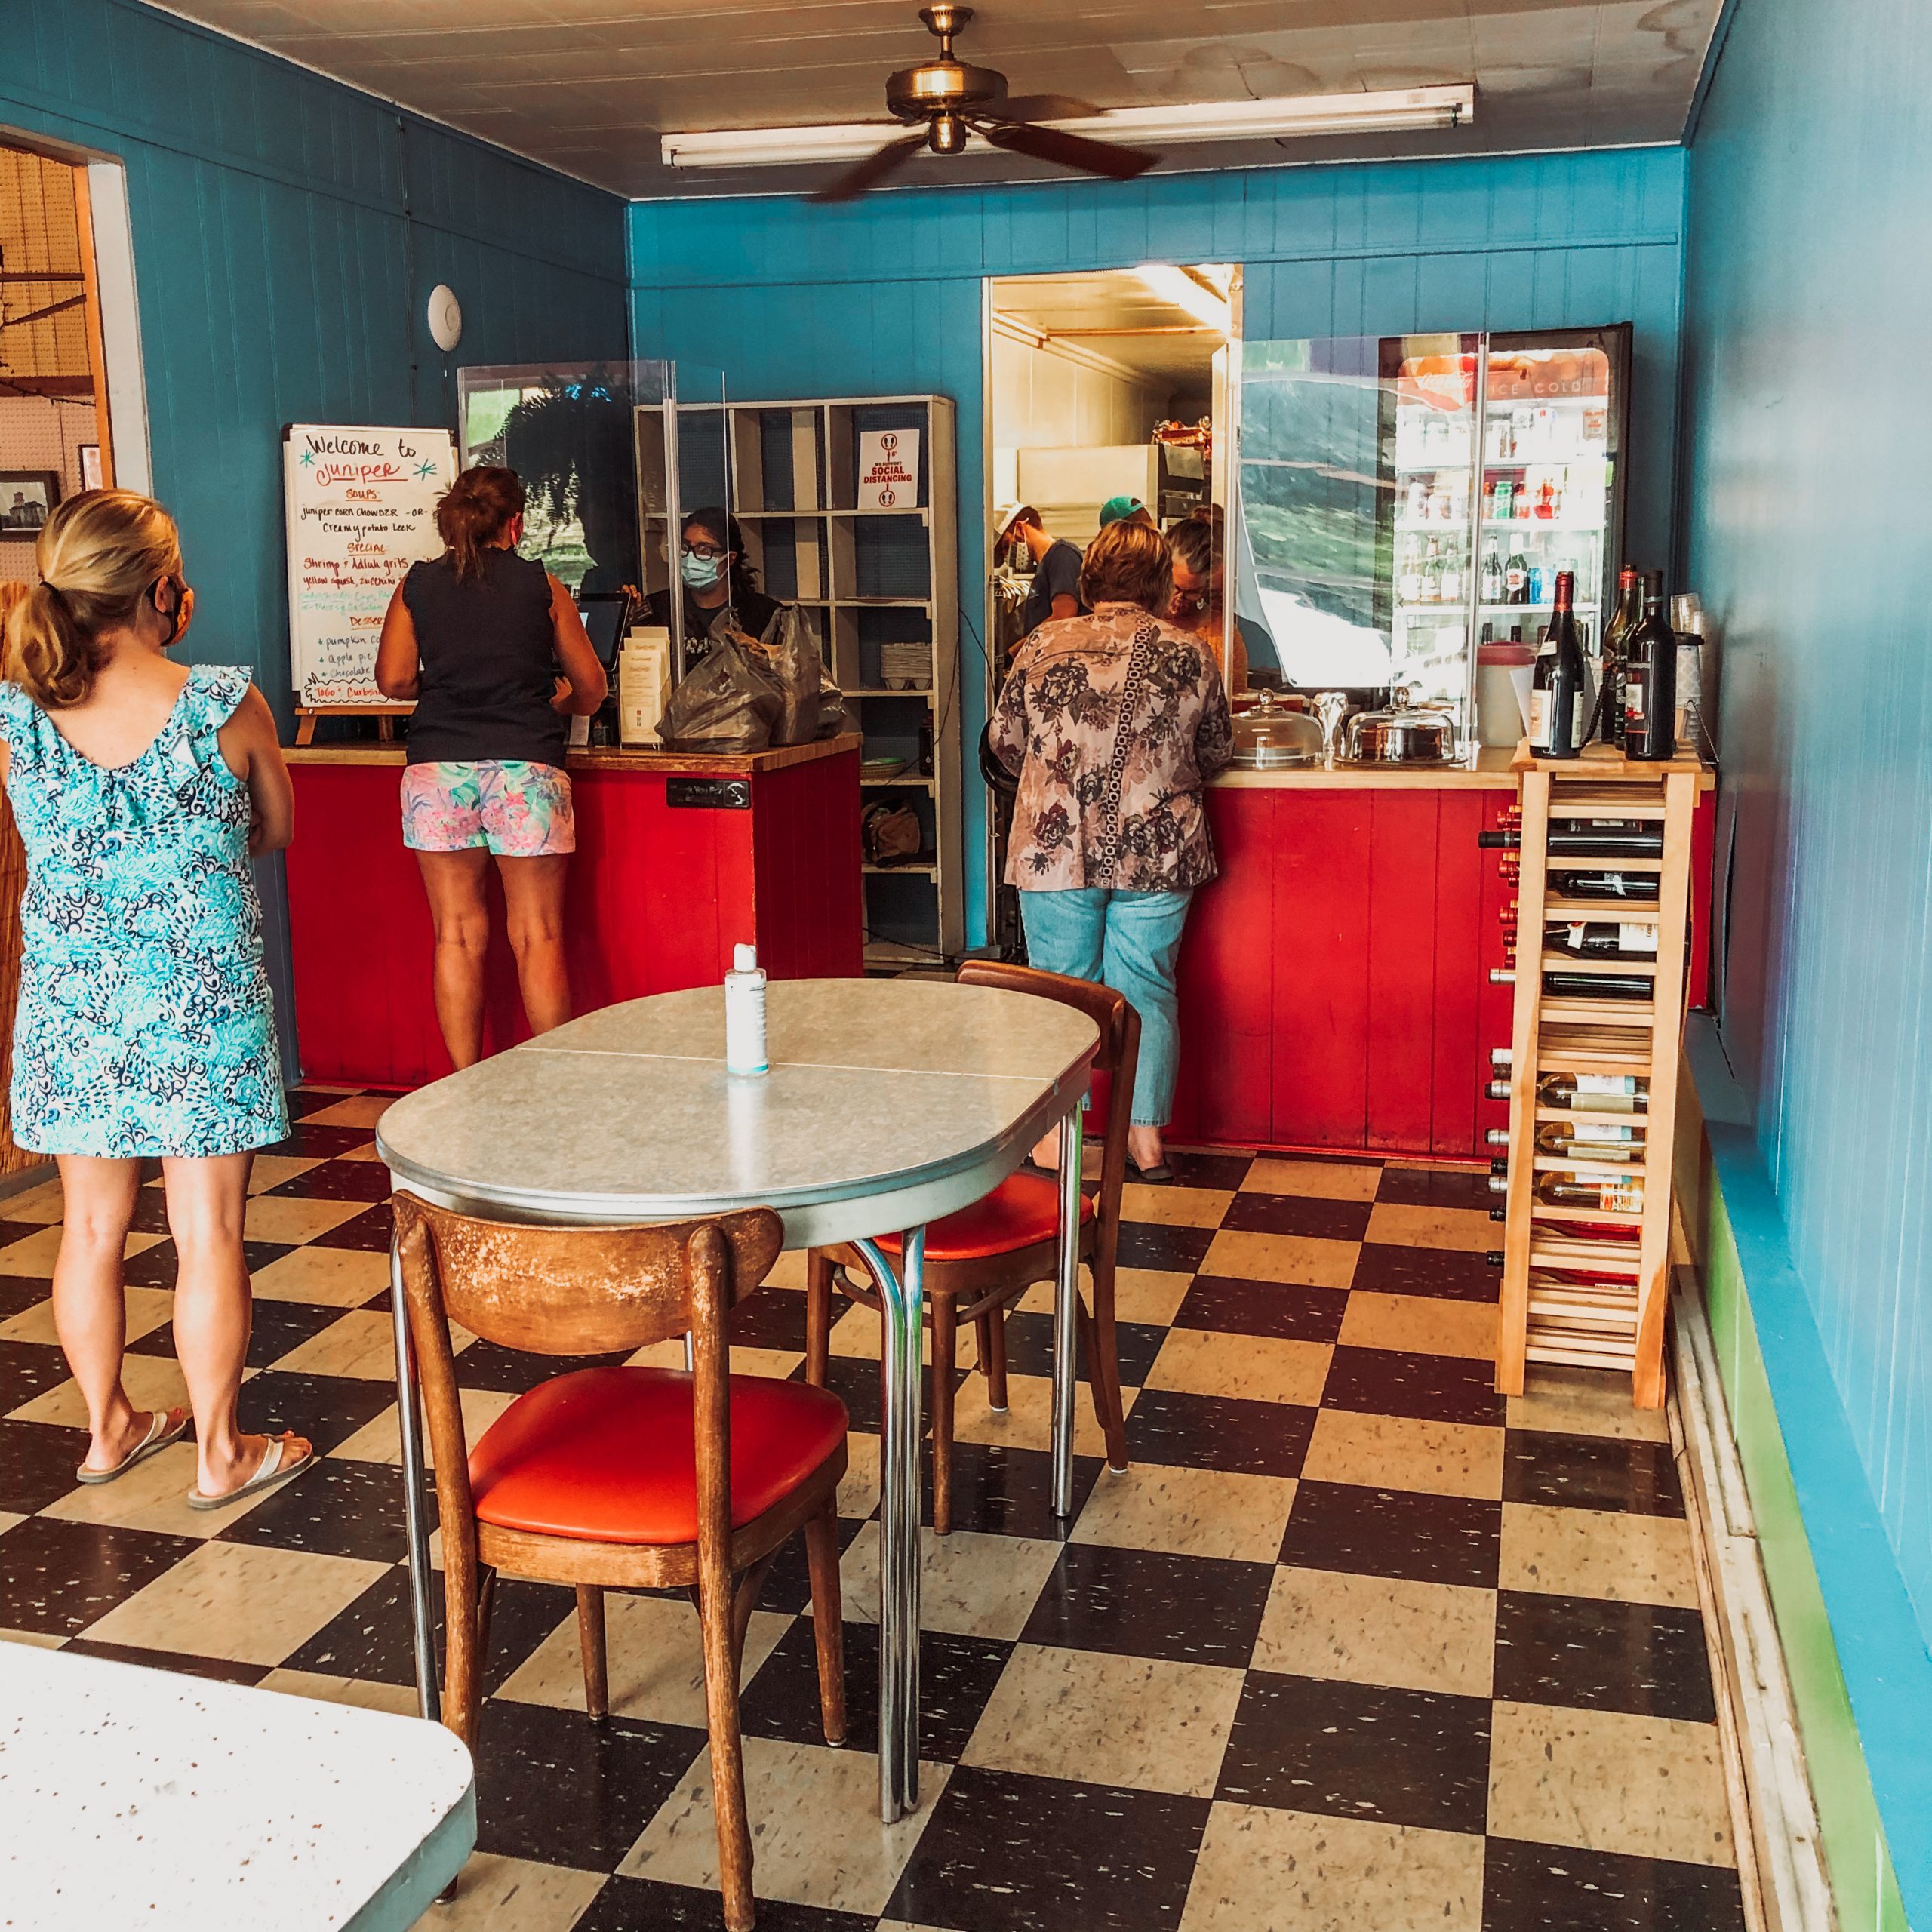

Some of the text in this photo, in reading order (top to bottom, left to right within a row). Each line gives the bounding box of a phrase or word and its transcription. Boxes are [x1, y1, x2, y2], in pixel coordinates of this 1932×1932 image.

[1535, 381, 1581, 393] COLD
[306, 435, 417, 457] Welcome to
[871, 466, 905, 475] SOCIAL
[863, 474, 912, 484] DISTANCING
[303, 557, 340, 577] Shrimp
[303, 576, 328, 591] yellow
[325, 635, 367, 651] pumpkin
[358, 653, 373, 664] pie
